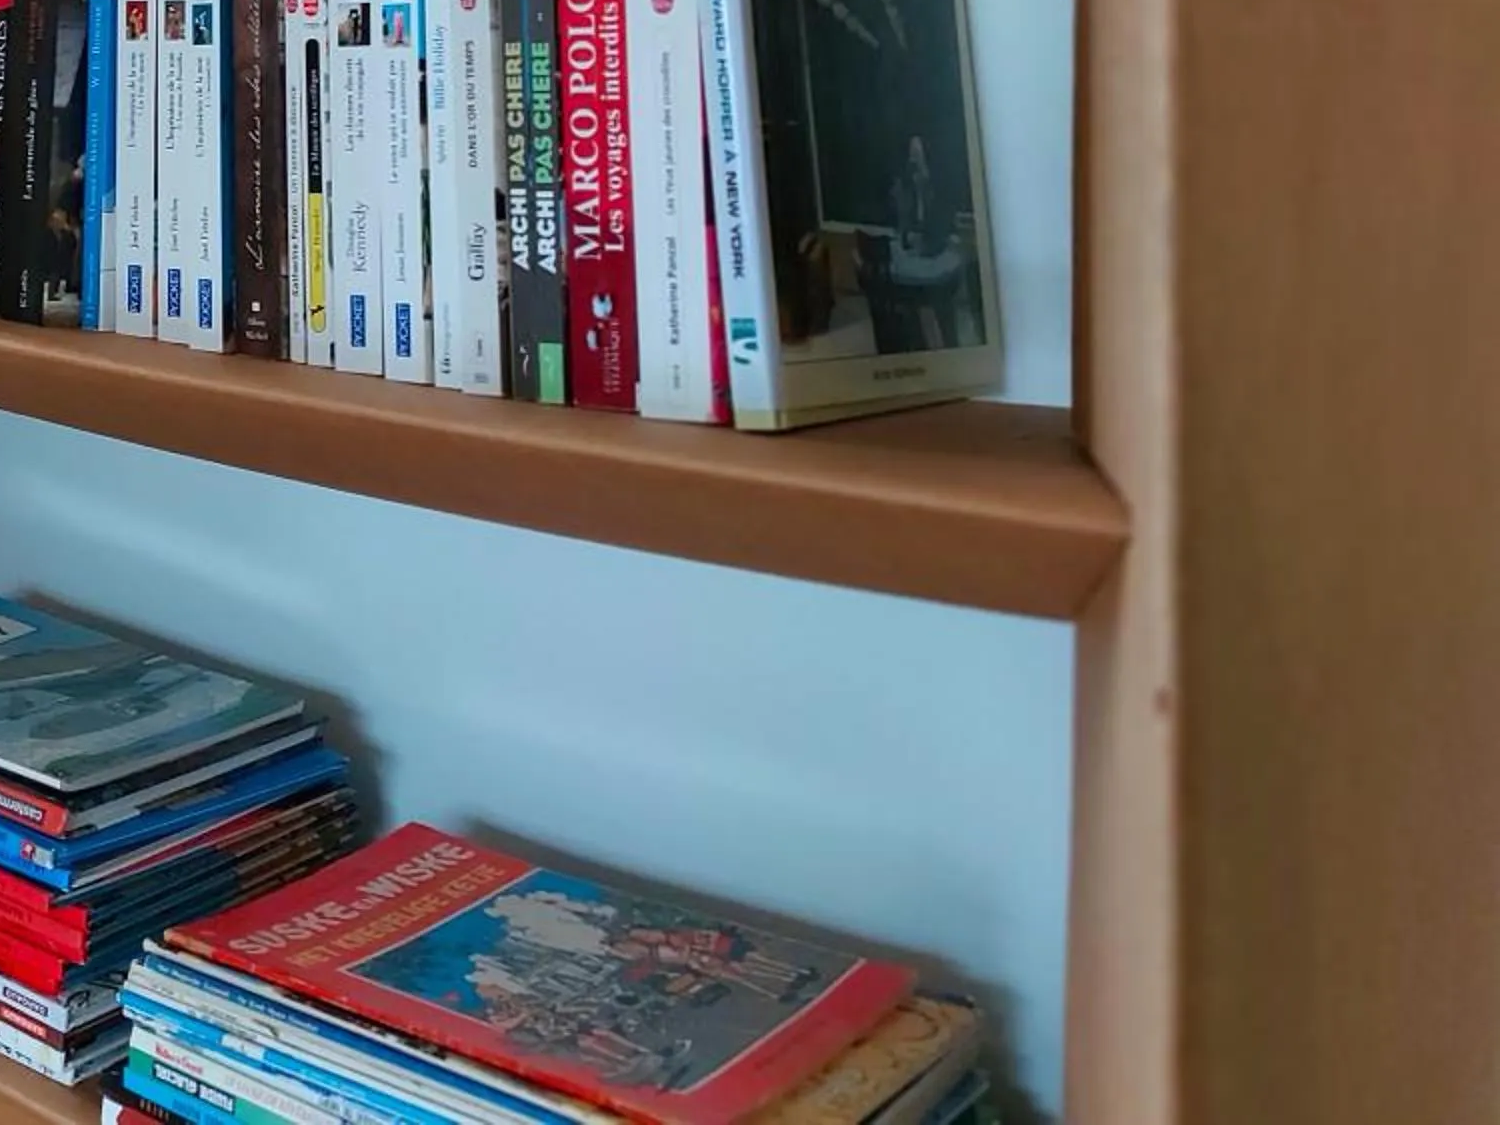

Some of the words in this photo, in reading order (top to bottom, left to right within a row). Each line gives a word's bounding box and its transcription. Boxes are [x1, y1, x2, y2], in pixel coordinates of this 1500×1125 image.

[432, 25, 447, 73] Holiday
[465, 40, 476, 80] TEMPS
[599, 1, 622, 101] interdits
[27, 79, 39, 110] glace
[246, 64, 262, 108] robes
[433, 77, 445, 110] Billie
[466, 82, 477, 100] DU
[505, 42, 524, 129] CHERE
[531, 42, 552, 130] CHERE
[716, 58, 734, 141] HOPPER
[247, 116, 261, 150] des
[466, 103, 477, 131] L'OR
[661, 108, 672, 127] des
[25, 127, 36, 182] pyramide
[344, 134, 355, 153] Les
[467, 134, 479, 169] DANS
[508, 134, 526, 182] PAS
[534, 136, 554, 184] PAS
[604, 109, 628, 202] voyages
[662, 130, 675, 166] jaunes
[22, 184, 33, 201] La
[569, 107, 602, 260] MARCO
[665, 198, 675, 216] Les
[725, 170, 741, 217] NEW
[246, 158, 263, 270] L'armoire
[351, 201, 369, 273] Kennedy
[510, 188, 530, 271] ARCHI
[535, 190, 557, 274] ARCHI
[604, 209, 625, 252] Les
[467, 223, 487, 282] Gallay
[665, 236, 678, 278] Pancol
[729, 224, 746, 280] YORK
[129, 266, 140, 313] POCKET
[168, 268, 180, 317] POCKET
[198, 280, 211, 329] POCKET
[668, 282, 680, 345] Katherine
[351, 295, 365, 347] POCKET
[396, 303, 410, 357] POCKET
[227, 899, 360, 956] SUSKE
[355, 842, 476, 898] WISKE
[285, 941, 341, 968] HET
